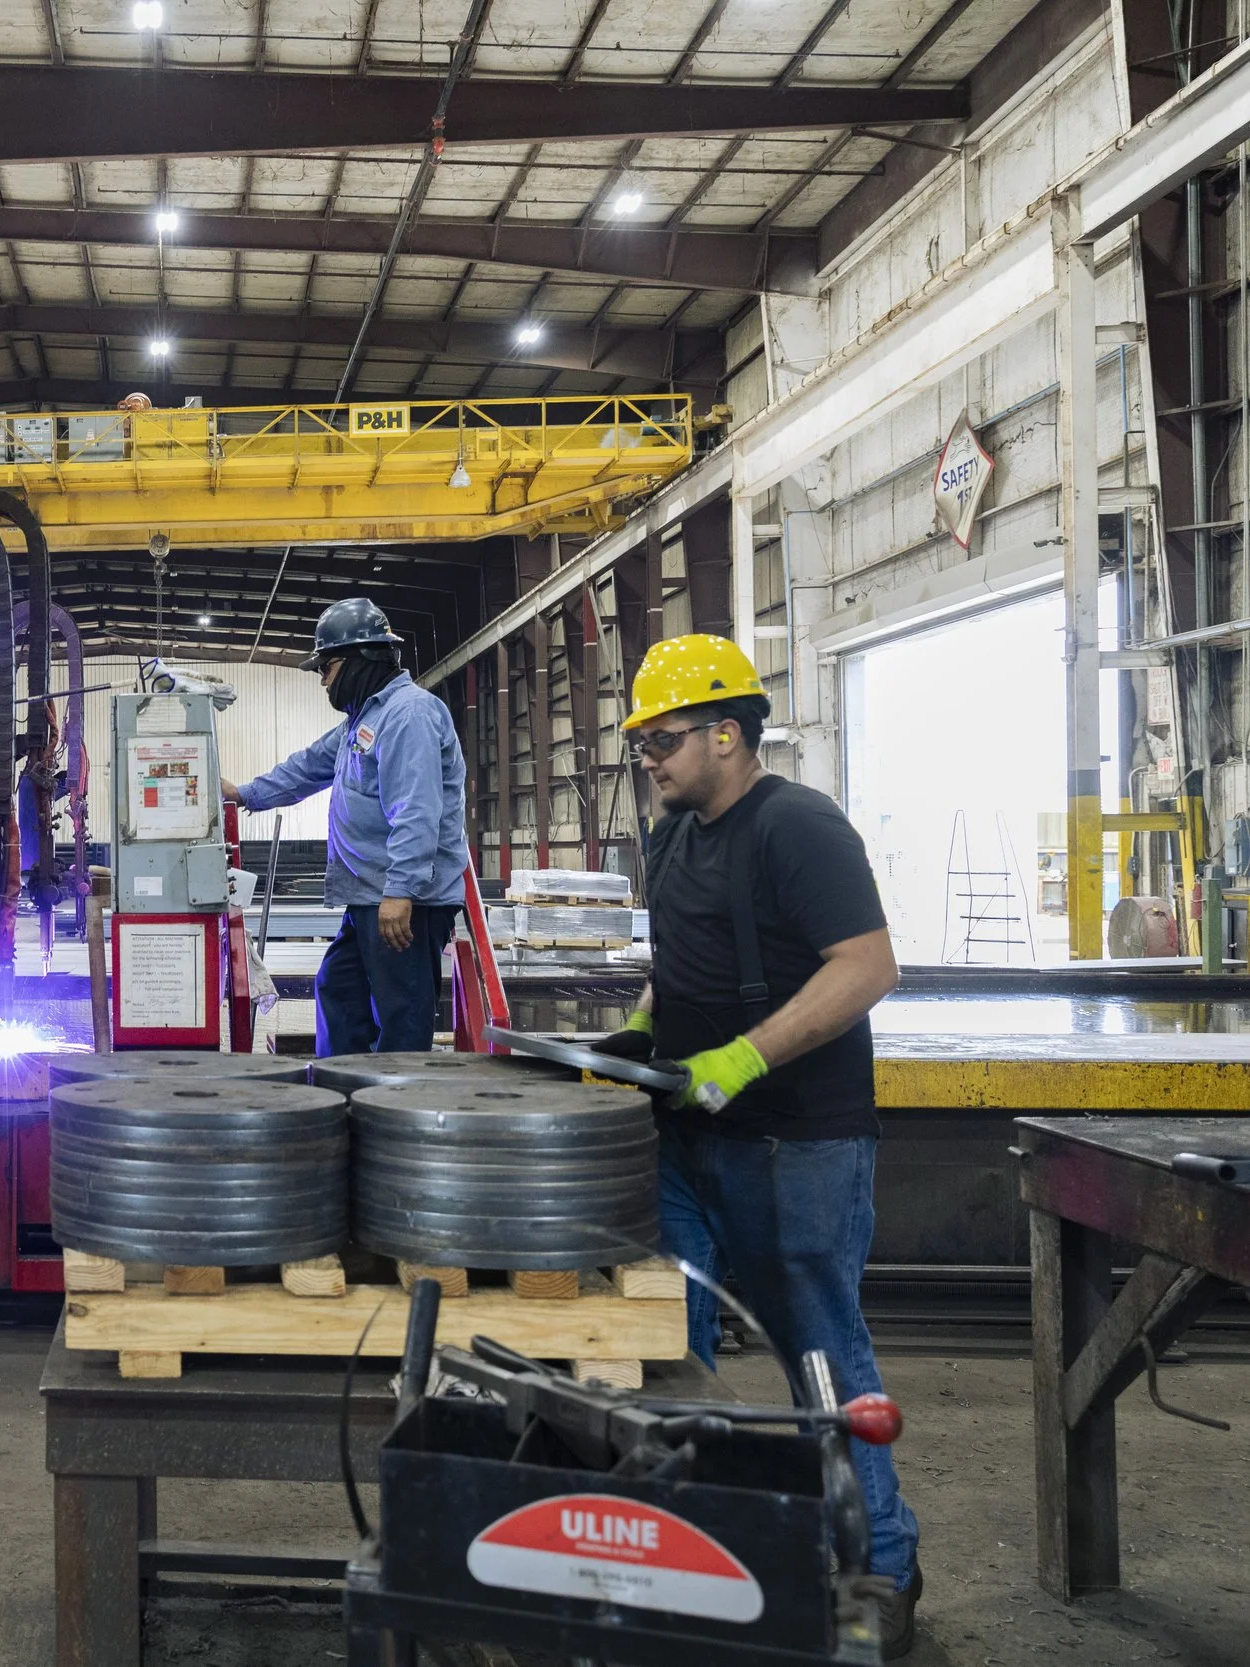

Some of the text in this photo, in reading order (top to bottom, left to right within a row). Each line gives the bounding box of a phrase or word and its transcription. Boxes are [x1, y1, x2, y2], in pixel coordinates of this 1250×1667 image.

[357, 410, 403, 430] P&H
[941, 455, 980, 491] SAFETY
[561, 1509, 659, 1550] ULINE
